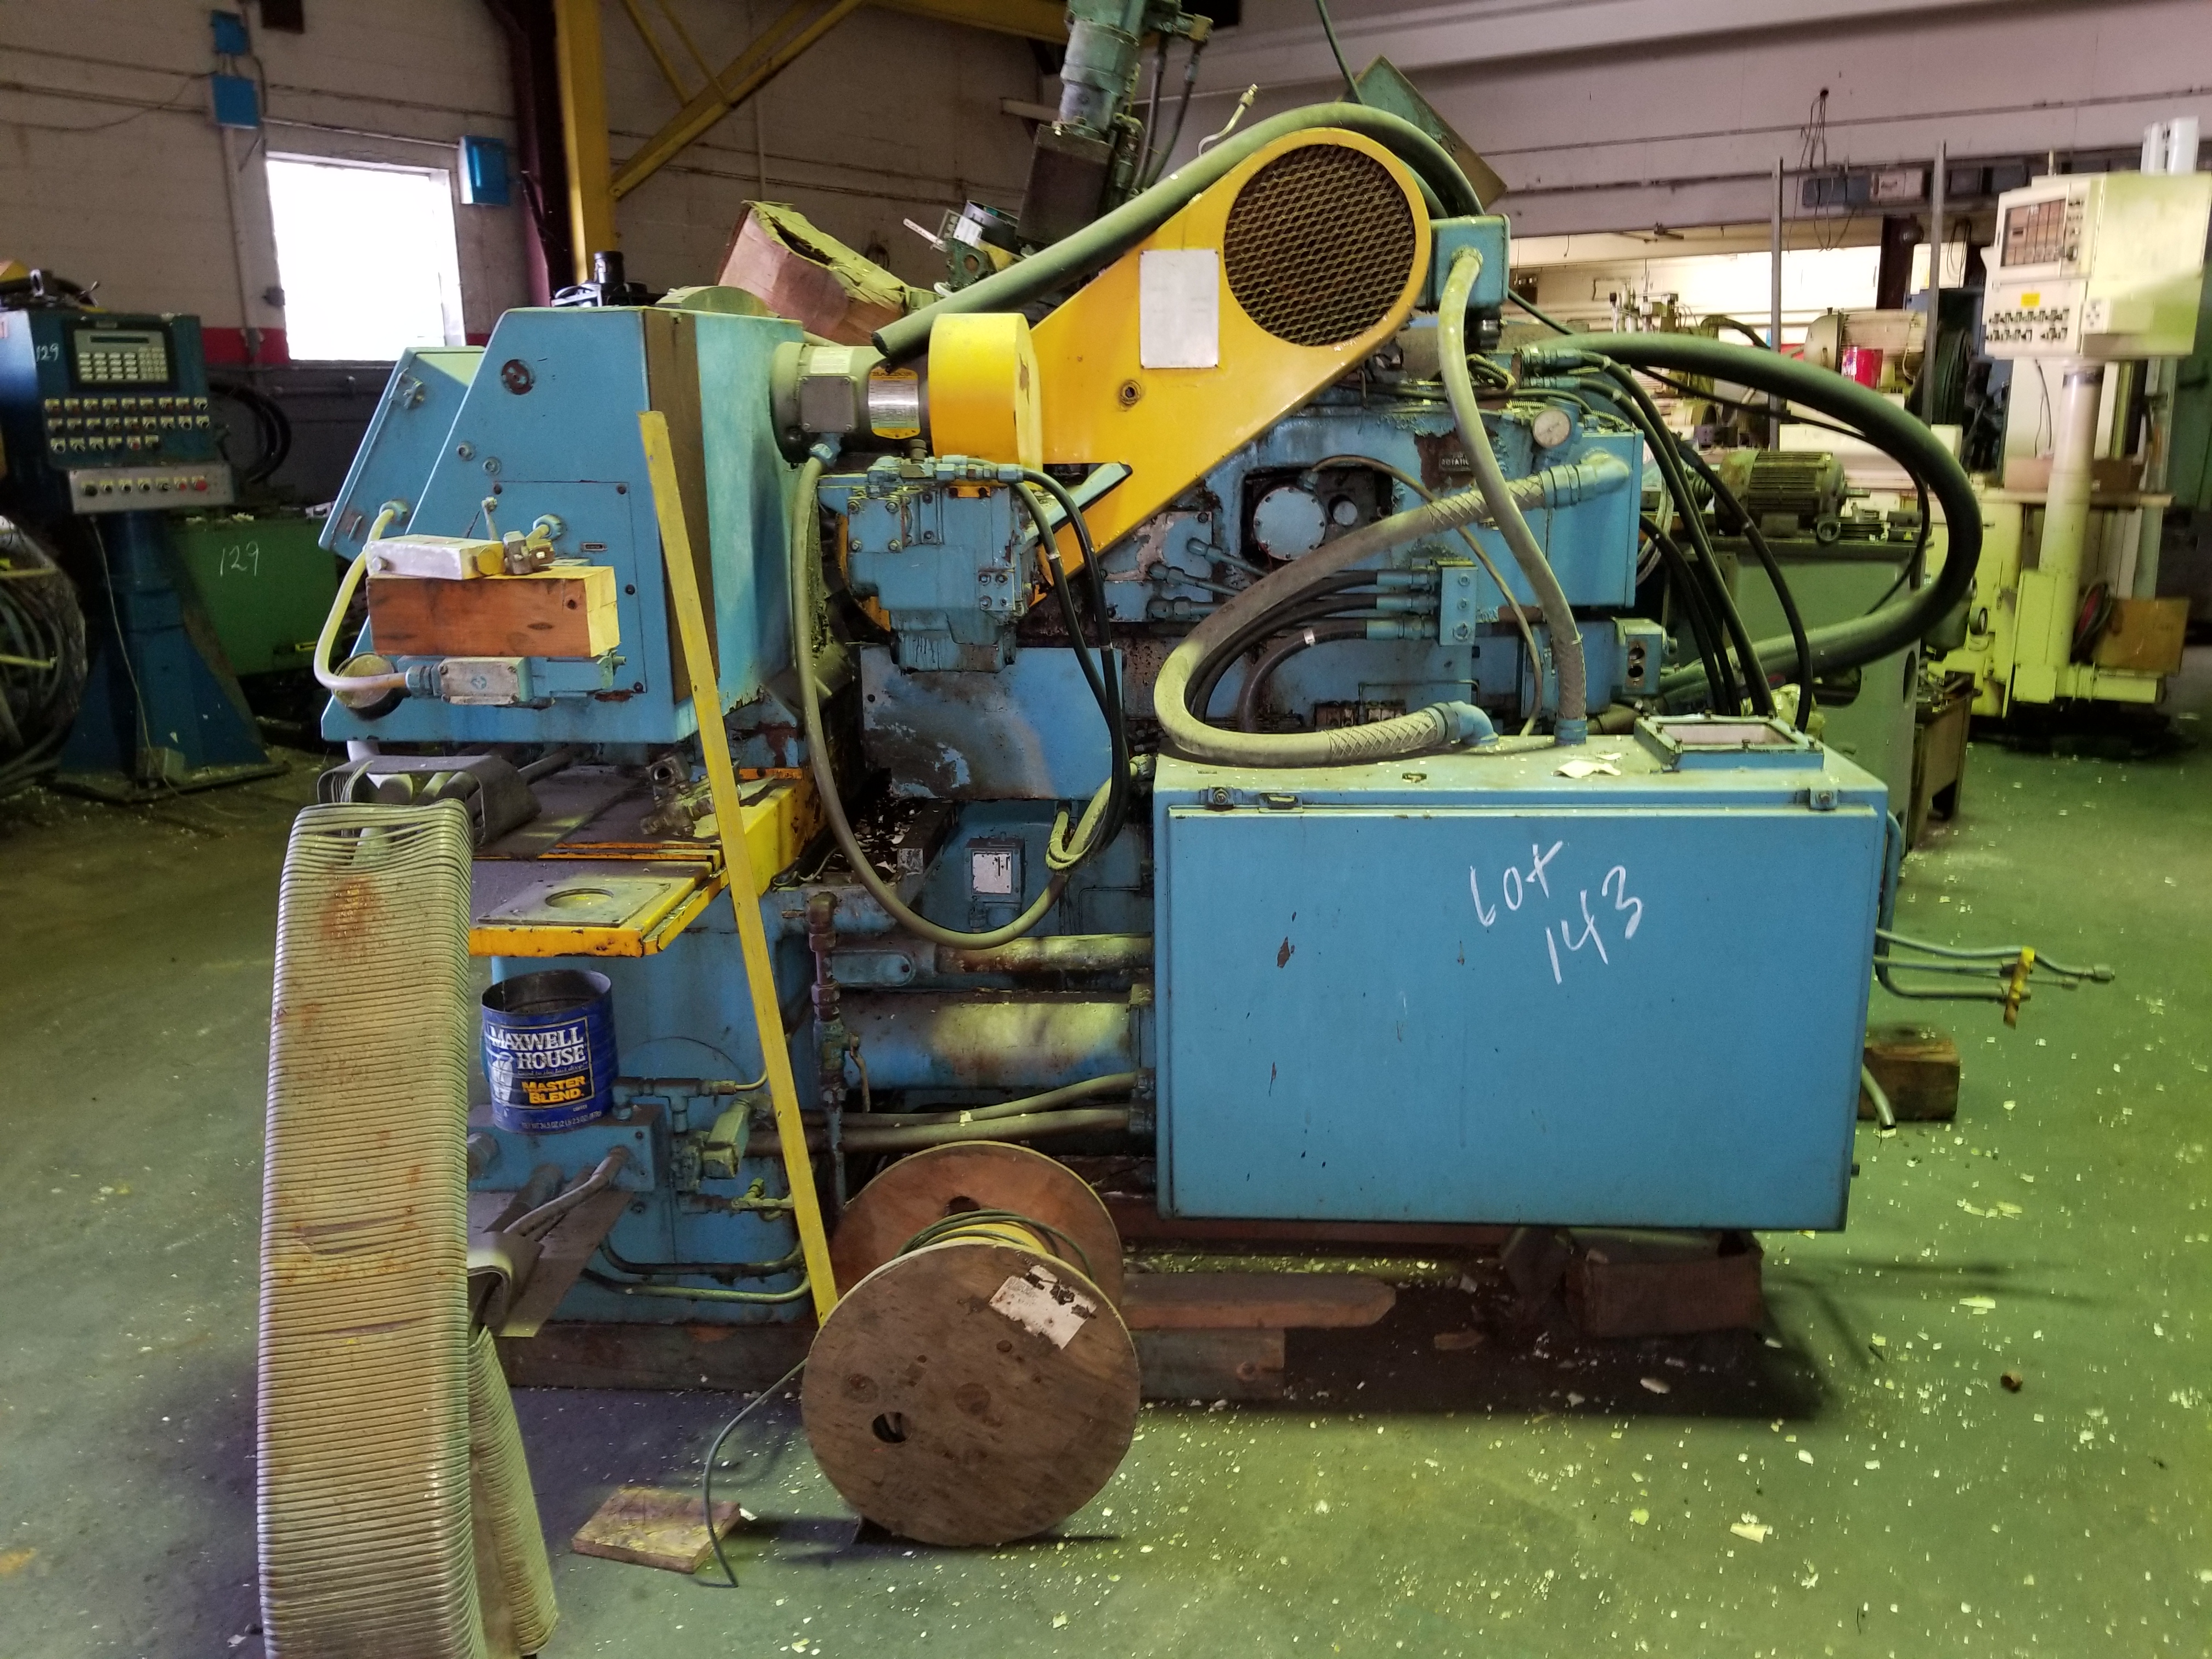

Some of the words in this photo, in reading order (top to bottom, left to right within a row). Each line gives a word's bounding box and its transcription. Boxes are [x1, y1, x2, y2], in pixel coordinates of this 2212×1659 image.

[36, 343, 59, 362] 129
[219, 541, 258, 577] 129
[1544, 865, 1643, 985] 143
[489, 1025, 584, 1051] MAXWELL
[515, 1044, 586, 1070] HOUSE
[522, 1076, 585, 1092] MASTER
